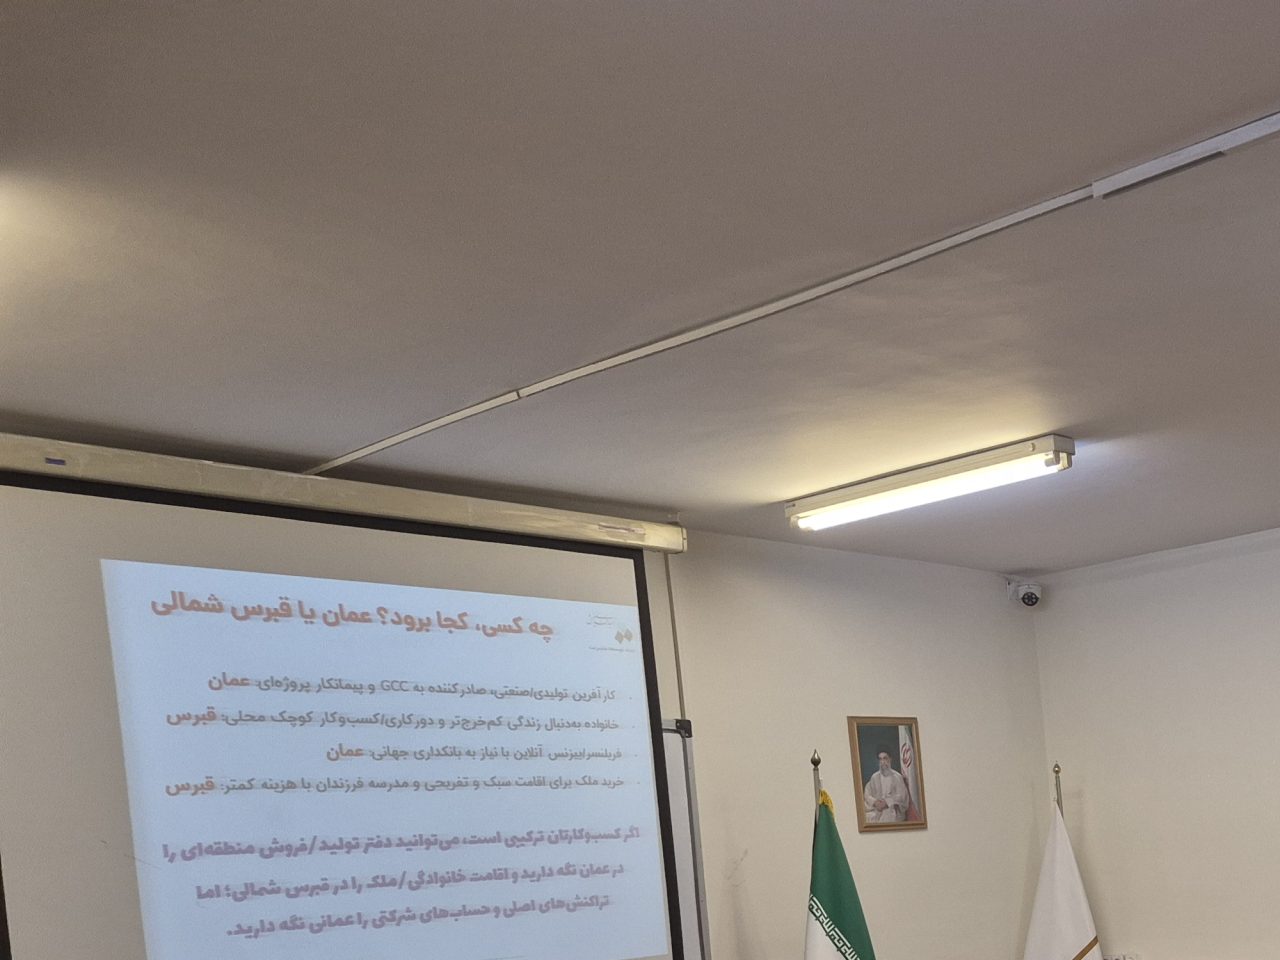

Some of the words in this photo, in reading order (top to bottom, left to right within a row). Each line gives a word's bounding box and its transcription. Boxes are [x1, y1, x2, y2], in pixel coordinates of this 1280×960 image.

[151, 590, 225, 616] شمالی
[231, 596, 293, 622] قبرس
[298, 600, 316, 624] یا
[322, 603, 373, 627] عمان
[376, 606, 432, 634] برود؟
[436, 611, 468, 634] کجا
[475, 616, 523, 638] کسی،
[529, 621, 554, 643] چه
[208, 672, 251, 690] عمان
[316, 677, 363, 694] پیمانکار
[368, 684, 376, 694] و
[380, 680, 409, 692] GCC
[413, 683, 424, 694] به
[166, 706, 217, 726] قبرس
[221, 710, 266, 726] محلی:
[271, 710, 314, 727] کوچک
[438, 718, 446, 729] و
[506, 715, 541, 731] زندگی
[584, 718, 619, 732] خانواده
[326, 743, 364, 761] عمان
[369, 745, 409, 761] جهانی:
[413, 746, 462, 761] بانکداری
[465, 749, 476, 760] به
[480, 747, 499, 761] نیاز
[501, 748, 510, 759] با
[514, 745, 543, 761] آنلاین
[165, 776, 216, 796] قبرس
[261, 779, 297, 793] هزینه
[301, 777, 311, 792] با
[316, 777, 364, 793] فرزندان
[368, 778, 409, 793] مدرسه
[424, 776, 469, 791] تفریحی
[483, 775, 511, 789] سبک
[514, 776, 546, 787] اقامت
[549, 776, 572, 790] برای
[575, 775, 598, 787] ملک
[601, 779, 624, 790] خرید
[504, 830, 544, 848] ترکیبی
[623, 825, 640, 843] اگر
[363, 835, 392, 854] دفتر
[162, 843, 176, 863] را
[469, 868, 508, 882] اقامت
[521, 866, 554, 882] دارید
[556, 862, 577, 877] نگه
[579, 864, 610, 878] عمان
[612, 864, 625, 878] در
[196, 884, 221, 900] اما
[285, 878, 330, 899] قبرس
[333, 879, 348, 895] در
[351, 876, 362, 894] را
[372, 906, 417, 929] شرکتی
[503, 900, 535, 919] اصلی
[279, 914, 305, 932] نگه
[309, 914, 354, 934] عمانی
[357, 911, 368, 930] را
